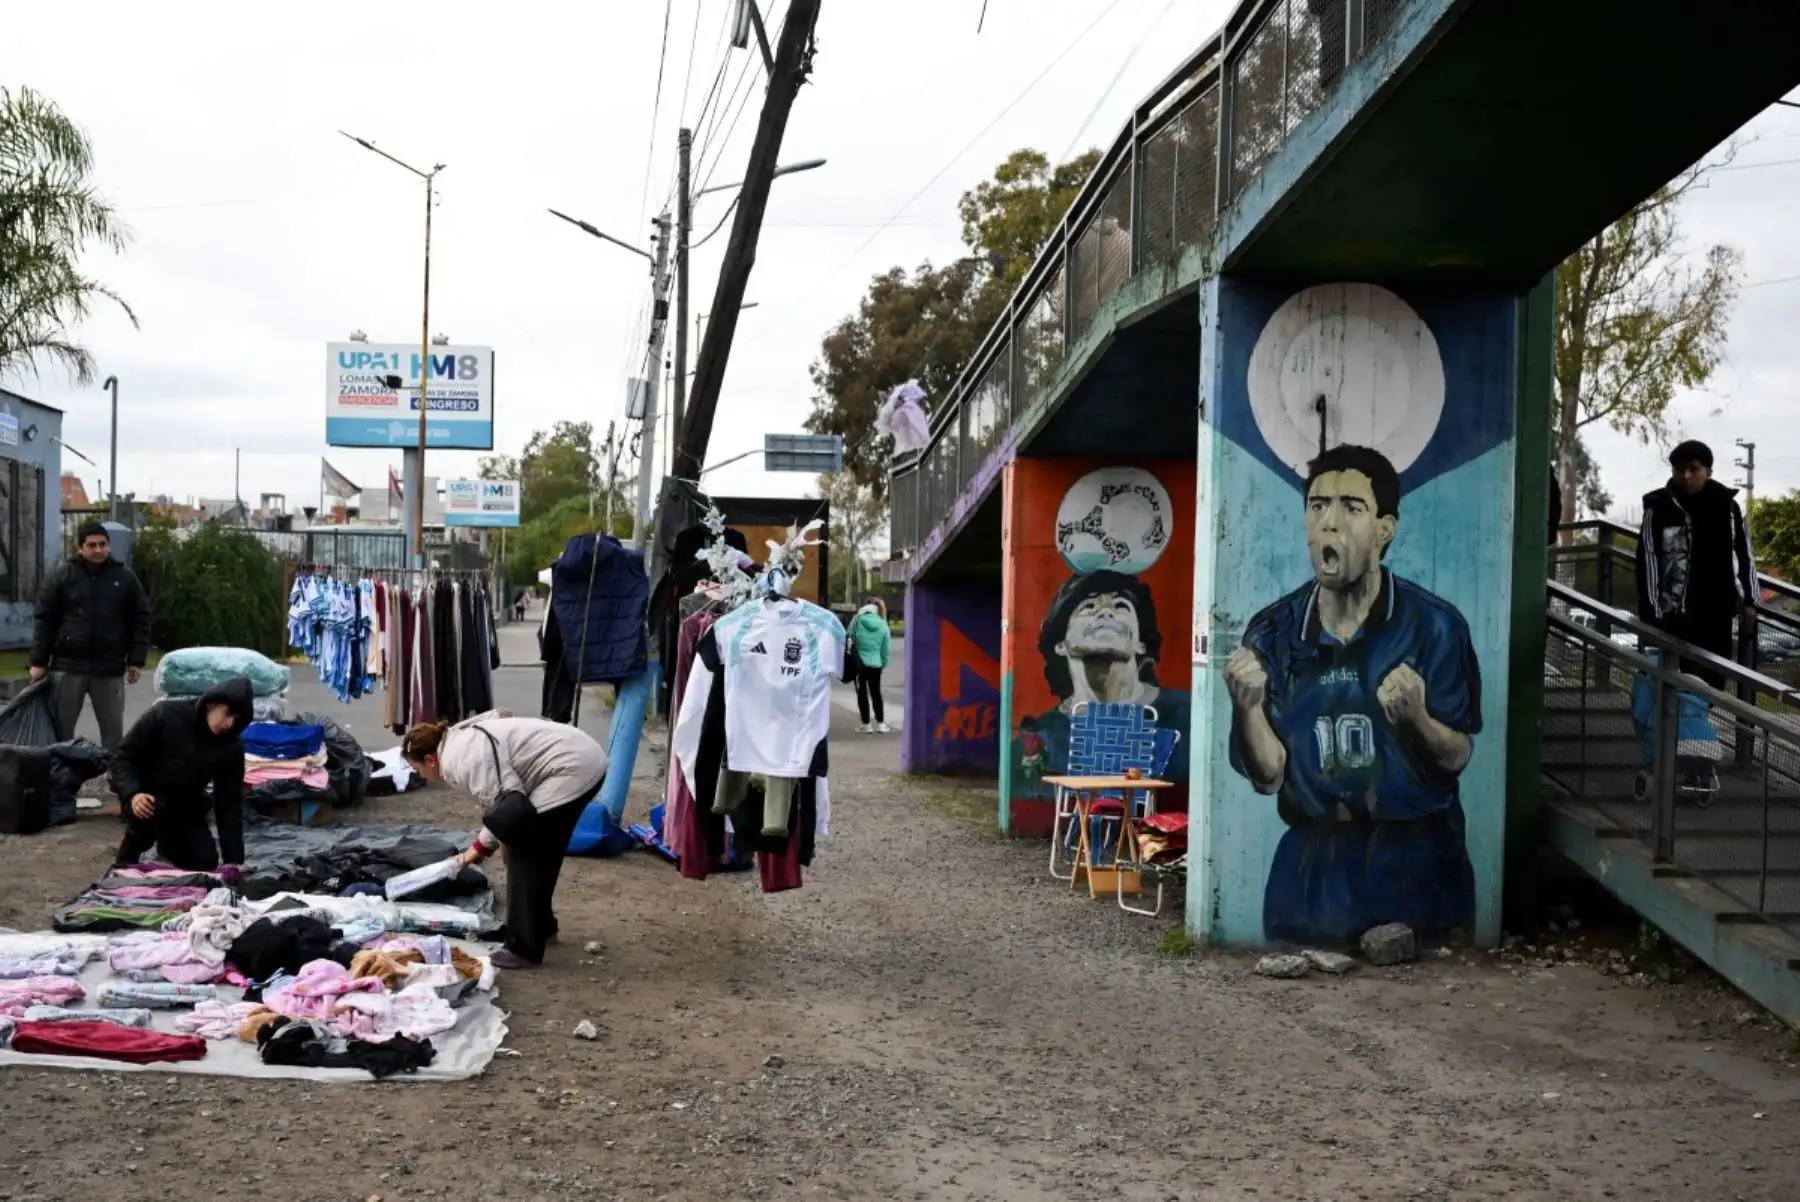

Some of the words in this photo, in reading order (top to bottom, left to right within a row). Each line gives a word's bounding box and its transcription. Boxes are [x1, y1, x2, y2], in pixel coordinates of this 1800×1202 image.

[338, 351, 399, 369] UPA1
[411, 353, 478, 380] HM8
[780, 666, 801, 677] YPF
[1313, 713, 1376, 769] 10
